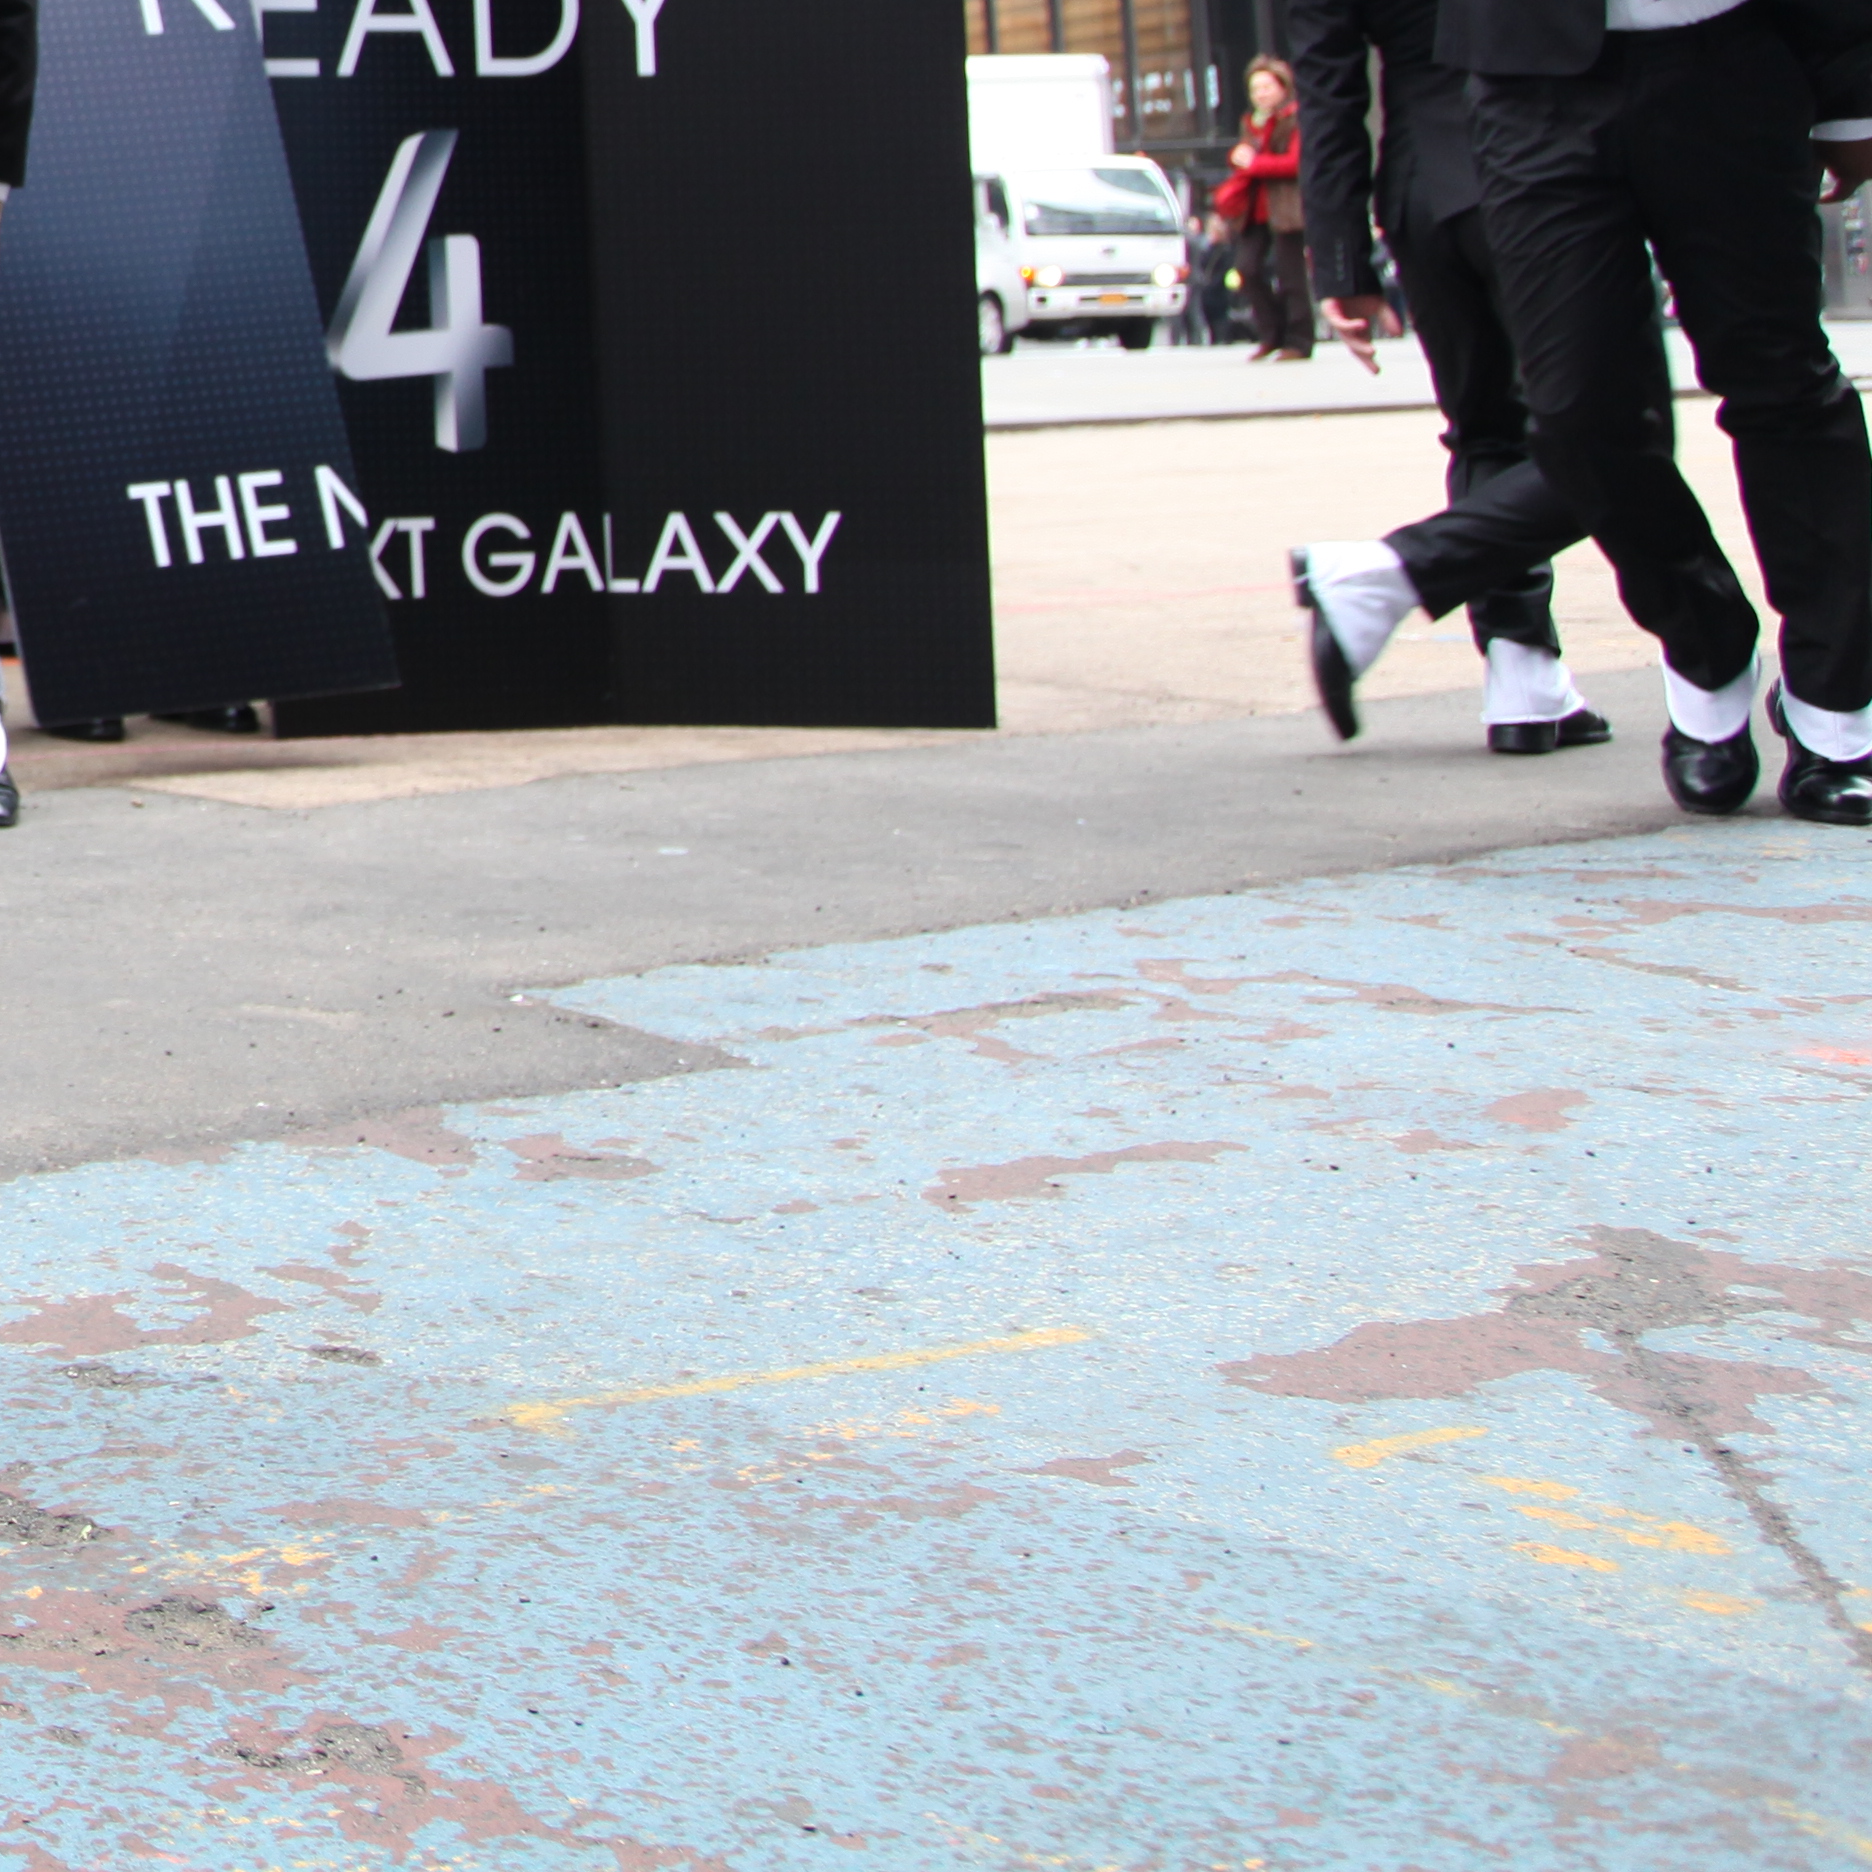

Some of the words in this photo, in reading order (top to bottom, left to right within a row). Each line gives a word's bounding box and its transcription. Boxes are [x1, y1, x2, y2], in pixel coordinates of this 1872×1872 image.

[326, 127, 515, 454] 4
[126, 469, 297, 567] THE
[462, 510, 842, 598] GALAXY
